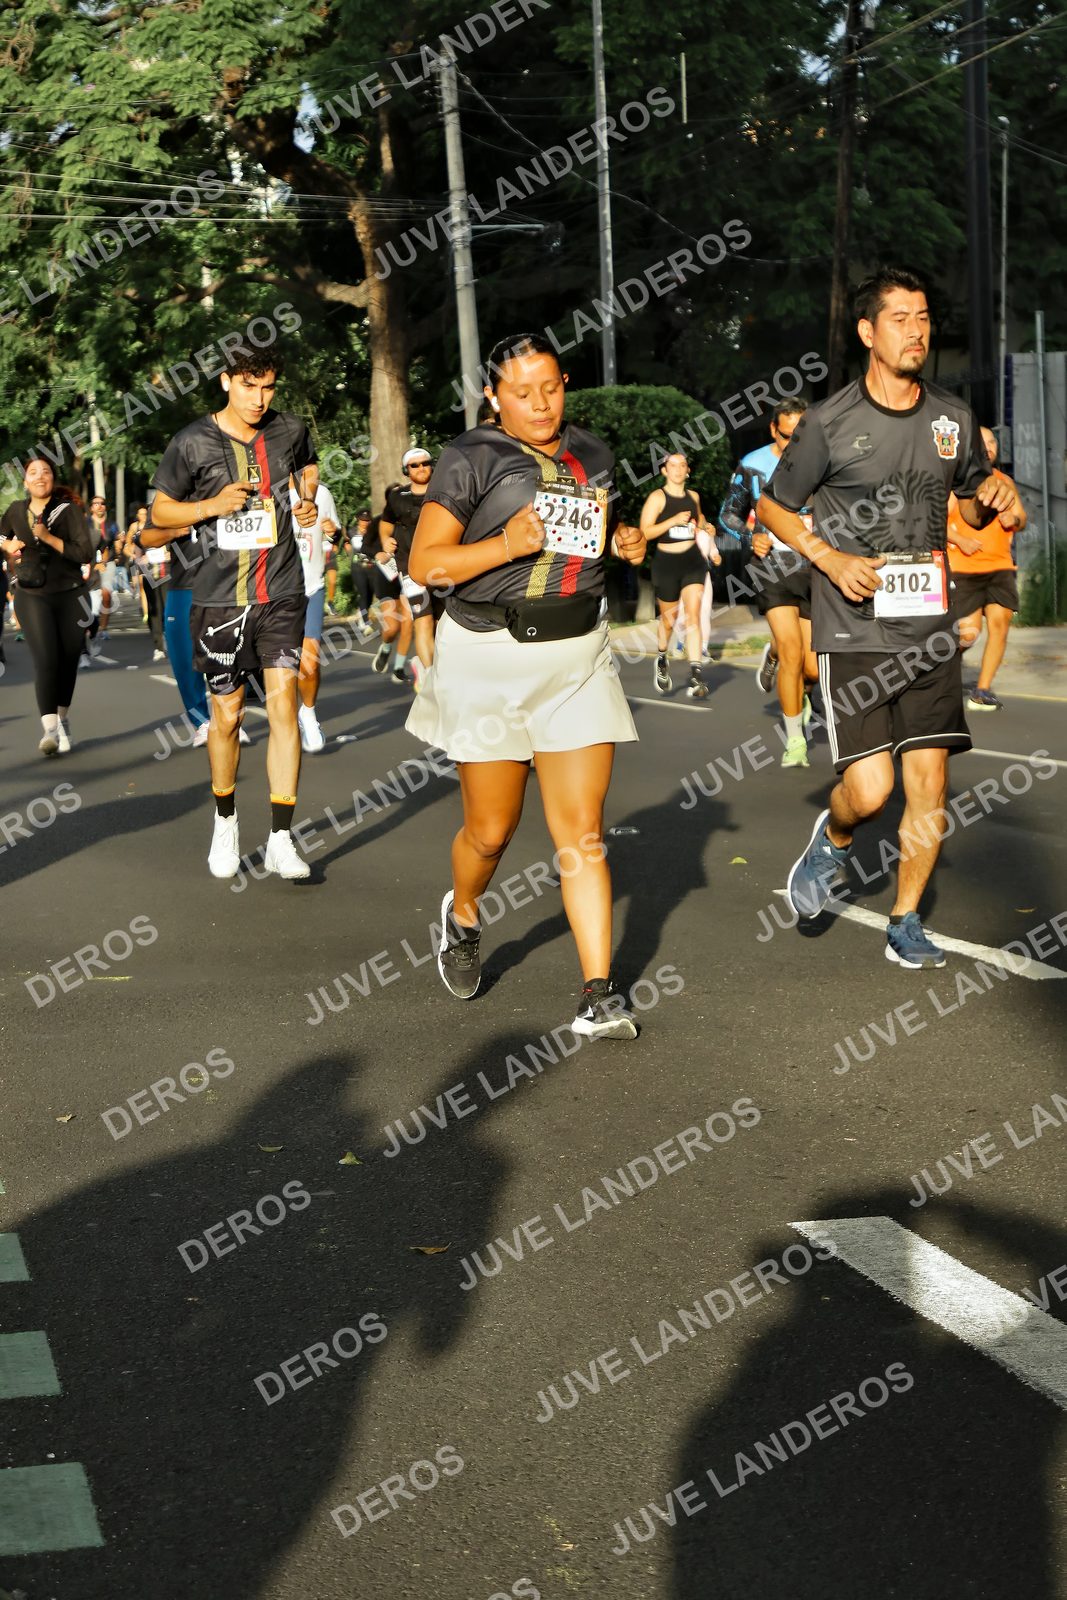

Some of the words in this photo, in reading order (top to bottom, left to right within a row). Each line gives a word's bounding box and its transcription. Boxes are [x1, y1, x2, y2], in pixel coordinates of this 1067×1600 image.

[224, 516, 263, 533] 6887
[543, 502, 593, 531] 2246
[885, 572, 932, 593] 8102
